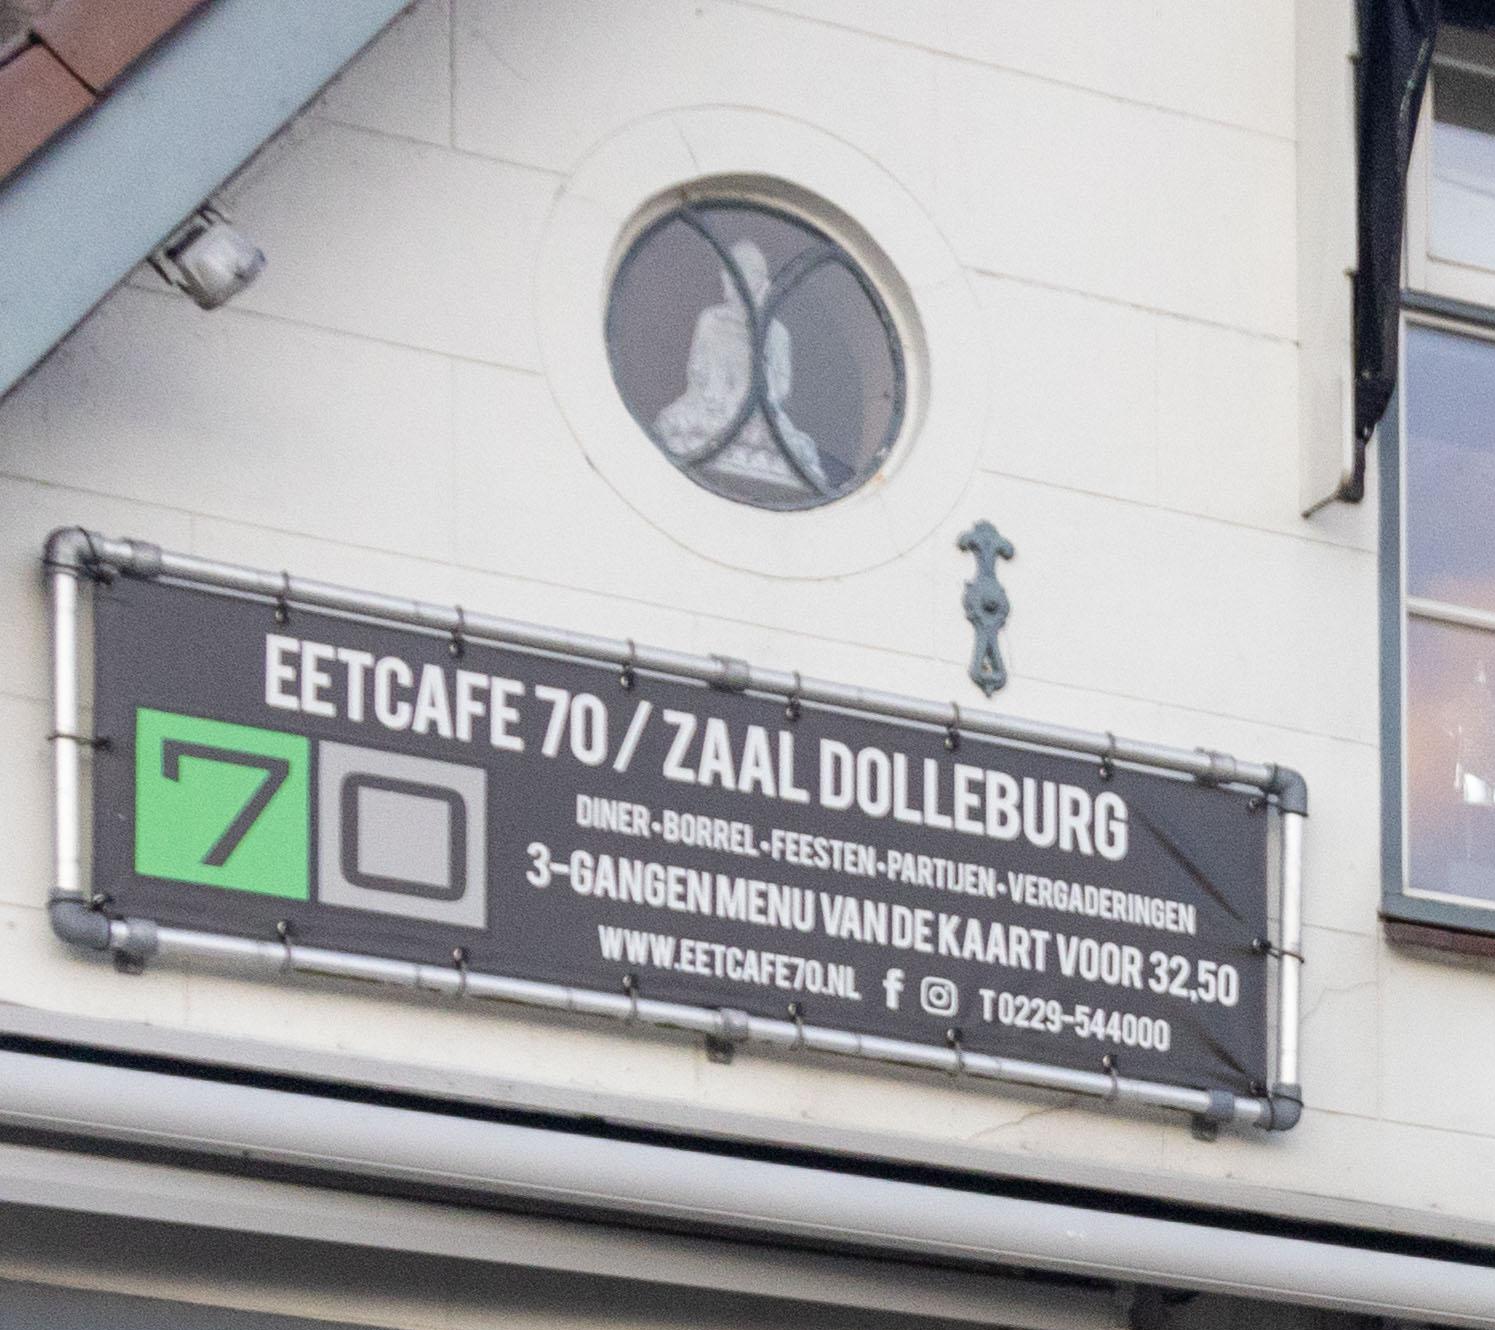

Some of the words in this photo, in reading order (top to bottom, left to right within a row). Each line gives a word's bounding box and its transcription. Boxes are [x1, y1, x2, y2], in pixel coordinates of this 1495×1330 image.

[265, 633, 526, 752] EETCAFE
[535, 685, 608, 767] 70
[613, 700, 653, 772] /
[663, 709, 811, 804] ZAAL
[819, 738, 1129, 862] DOLLEBURG
[526, 841, 713, 916] 3-GANGEN
[716, 874, 816, 933] MENU
[820, 892, 889, 946] VAN
[891, 904, 935, 954] DE
[938, 913, 1051, 973] KAART
[1056, 933, 1144, 990] VOOR
[1148, 951, 1240, 1008] 32,50
[598, 924, 862, 1001] WWW.EETCAFE70.NL
[998, 992, 1171, 1053] 0229-544000
